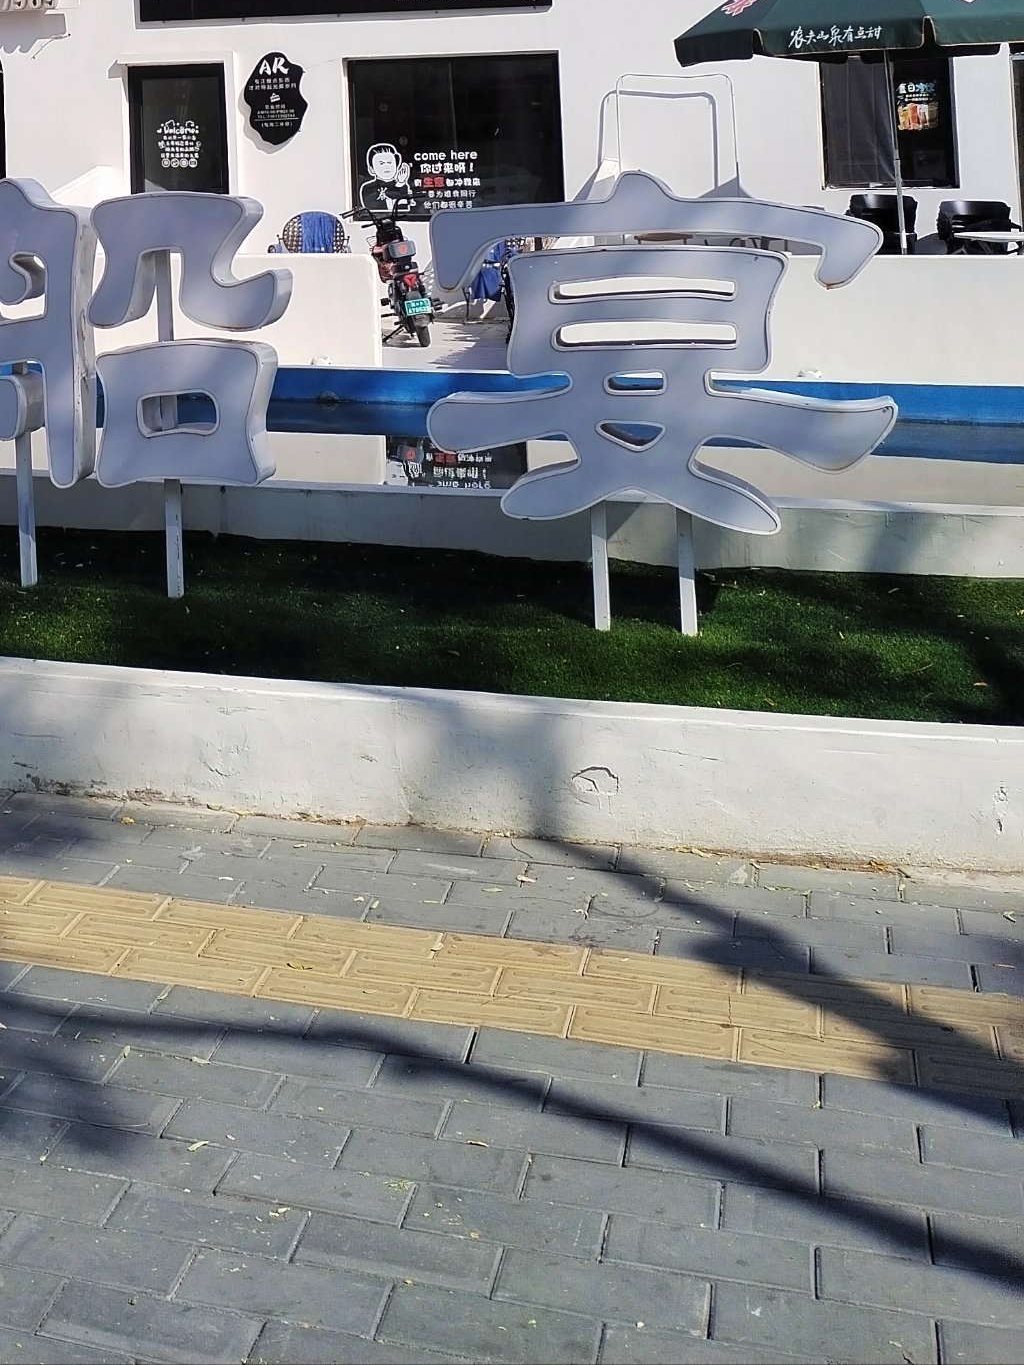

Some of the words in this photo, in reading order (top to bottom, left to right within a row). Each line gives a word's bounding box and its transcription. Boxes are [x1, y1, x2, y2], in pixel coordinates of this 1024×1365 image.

[788, 25, 883, 49] 农夫山泉有点甜
[259, 56, 289, 75] AR
[413, 152, 447, 161] come
[450, 149, 478, 160] here
